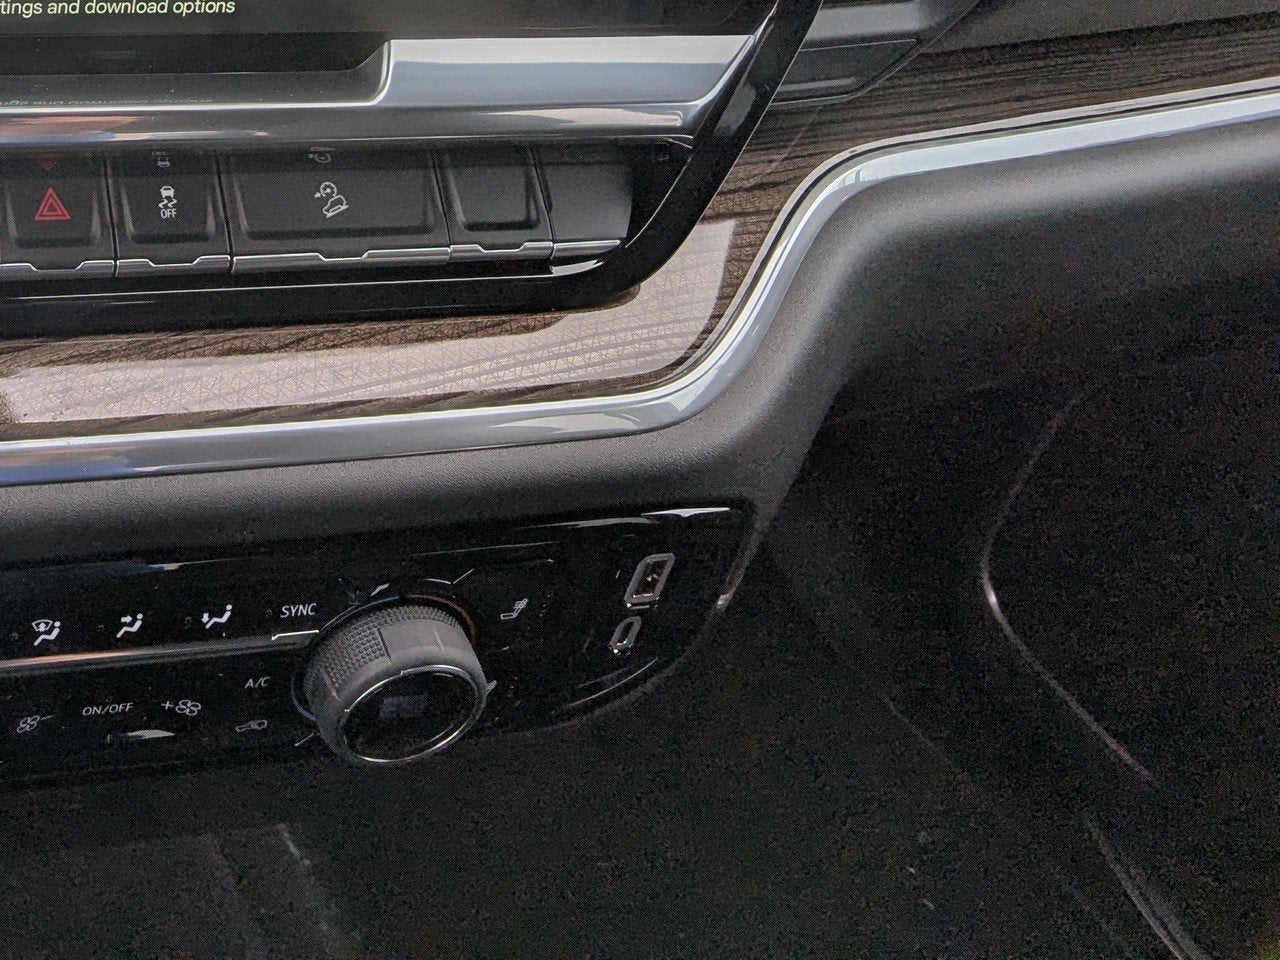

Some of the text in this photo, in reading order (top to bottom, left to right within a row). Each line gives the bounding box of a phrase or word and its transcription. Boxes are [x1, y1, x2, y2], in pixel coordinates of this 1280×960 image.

[160, 208, 178, 219] OFF
[280, 602, 317, 618] SYNC
[244, 676, 270, 690] A/C
[82, 702, 135, 717] ON/OFF
